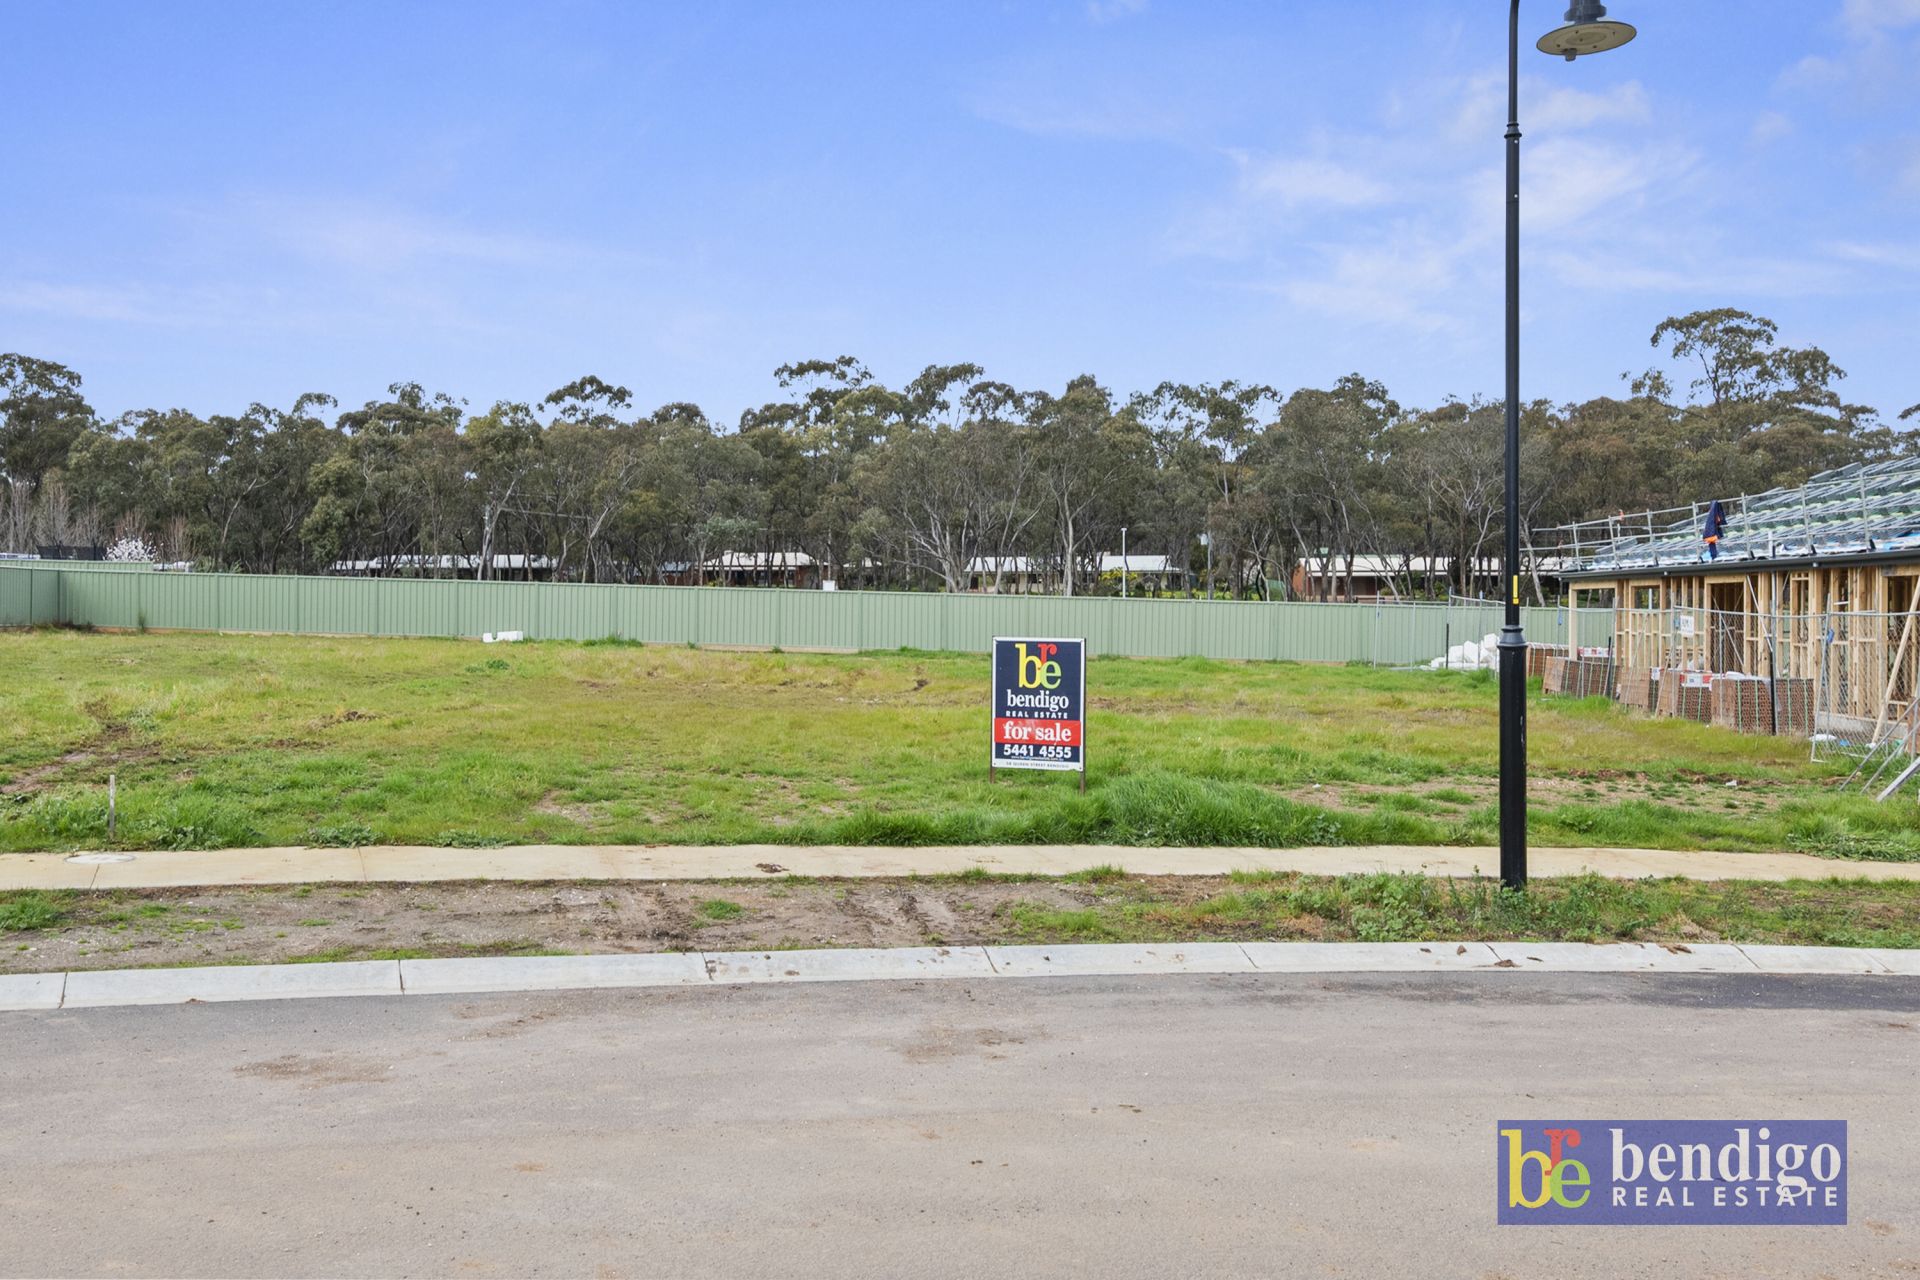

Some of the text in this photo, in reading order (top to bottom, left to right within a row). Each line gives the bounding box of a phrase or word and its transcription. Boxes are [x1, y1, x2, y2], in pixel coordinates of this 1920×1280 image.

[1006, 689, 1069, 712] bendigo
[1034, 711, 1068, 719] ESTATE
[1003, 721, 1072, 742] for sale
[1003, 744, 1034, 756] 5441
[1039, 745, 1072, 759] 4555
